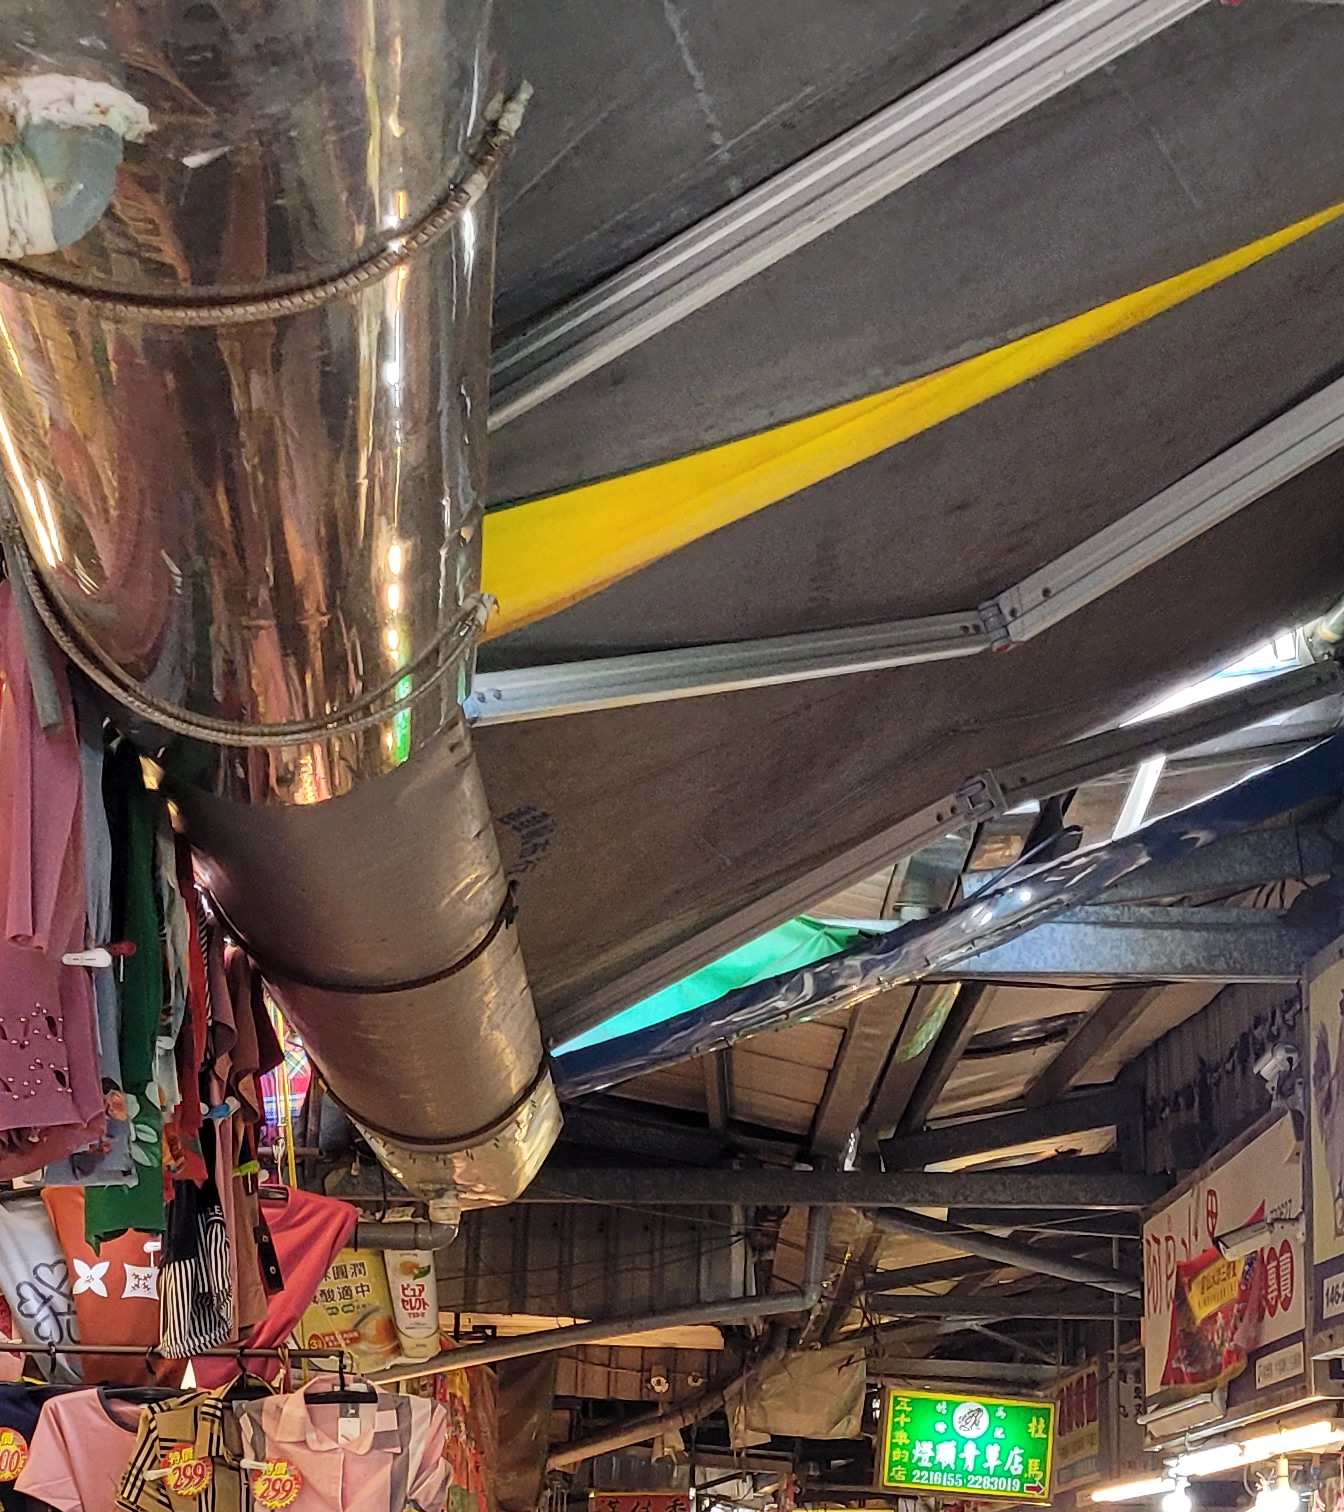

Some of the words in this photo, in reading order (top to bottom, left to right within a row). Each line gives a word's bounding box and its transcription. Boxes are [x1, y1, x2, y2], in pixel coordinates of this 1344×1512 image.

[400, 1283, 425, 1298] ピュア
[171, 1461, 206, 1490] 299
[258, 1476, 294, 1500] 299
